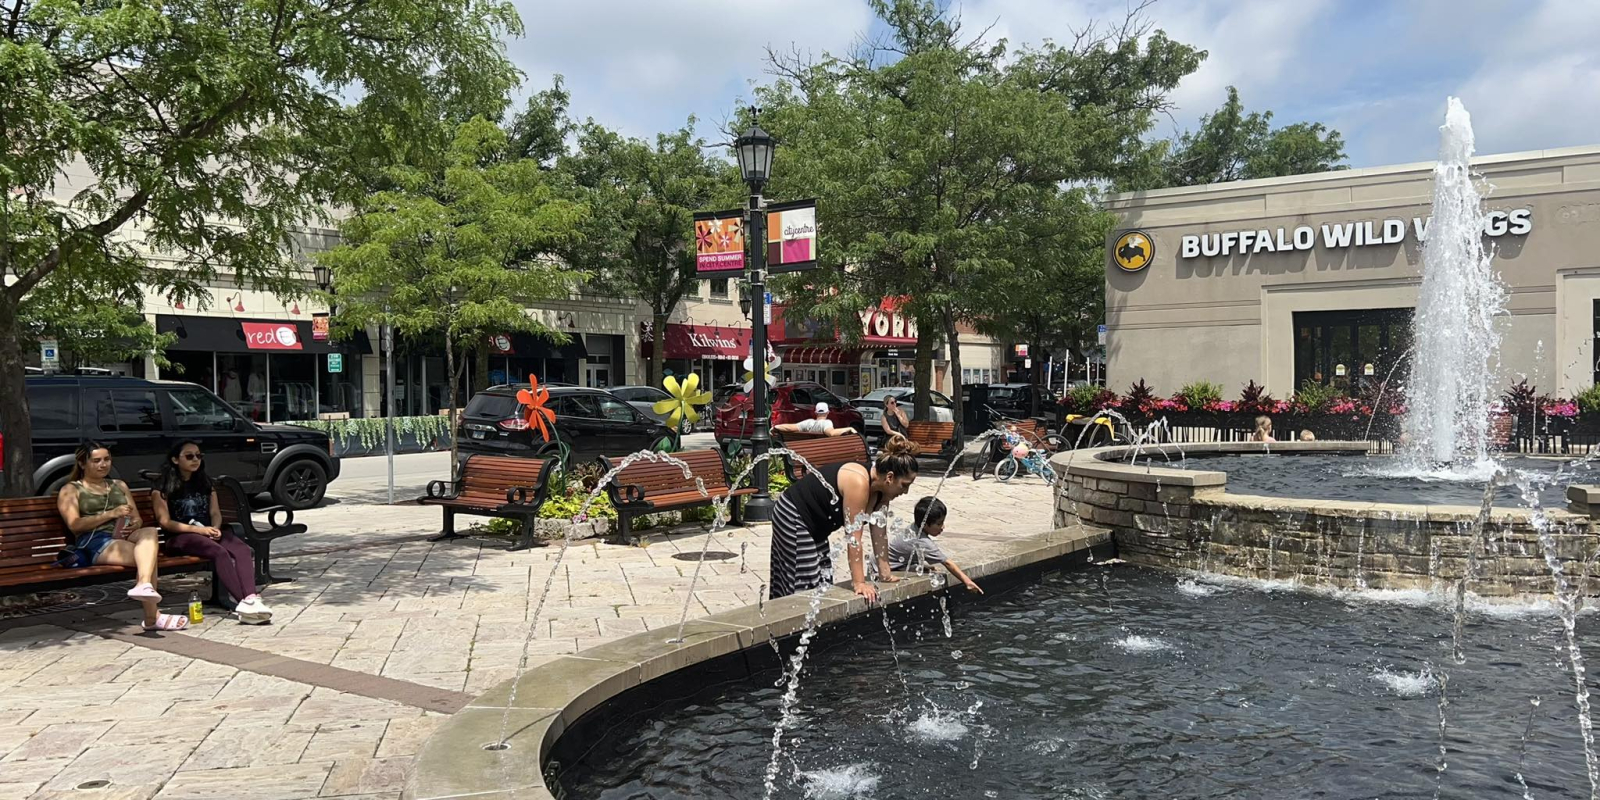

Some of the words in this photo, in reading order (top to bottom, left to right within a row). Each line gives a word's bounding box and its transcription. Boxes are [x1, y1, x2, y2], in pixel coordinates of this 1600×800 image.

[1181, 226, 1315, 258] BUFFALO
[1321, 219, 1405, 248] WILD
[1413, 208, 1532, 242] WGS
[717, 254, 742, 262] SUMMER
[858, 305, 918, 338] YORK
[247, 328, 277, 344] red
[688, 333, 736, 349] Kilwins
